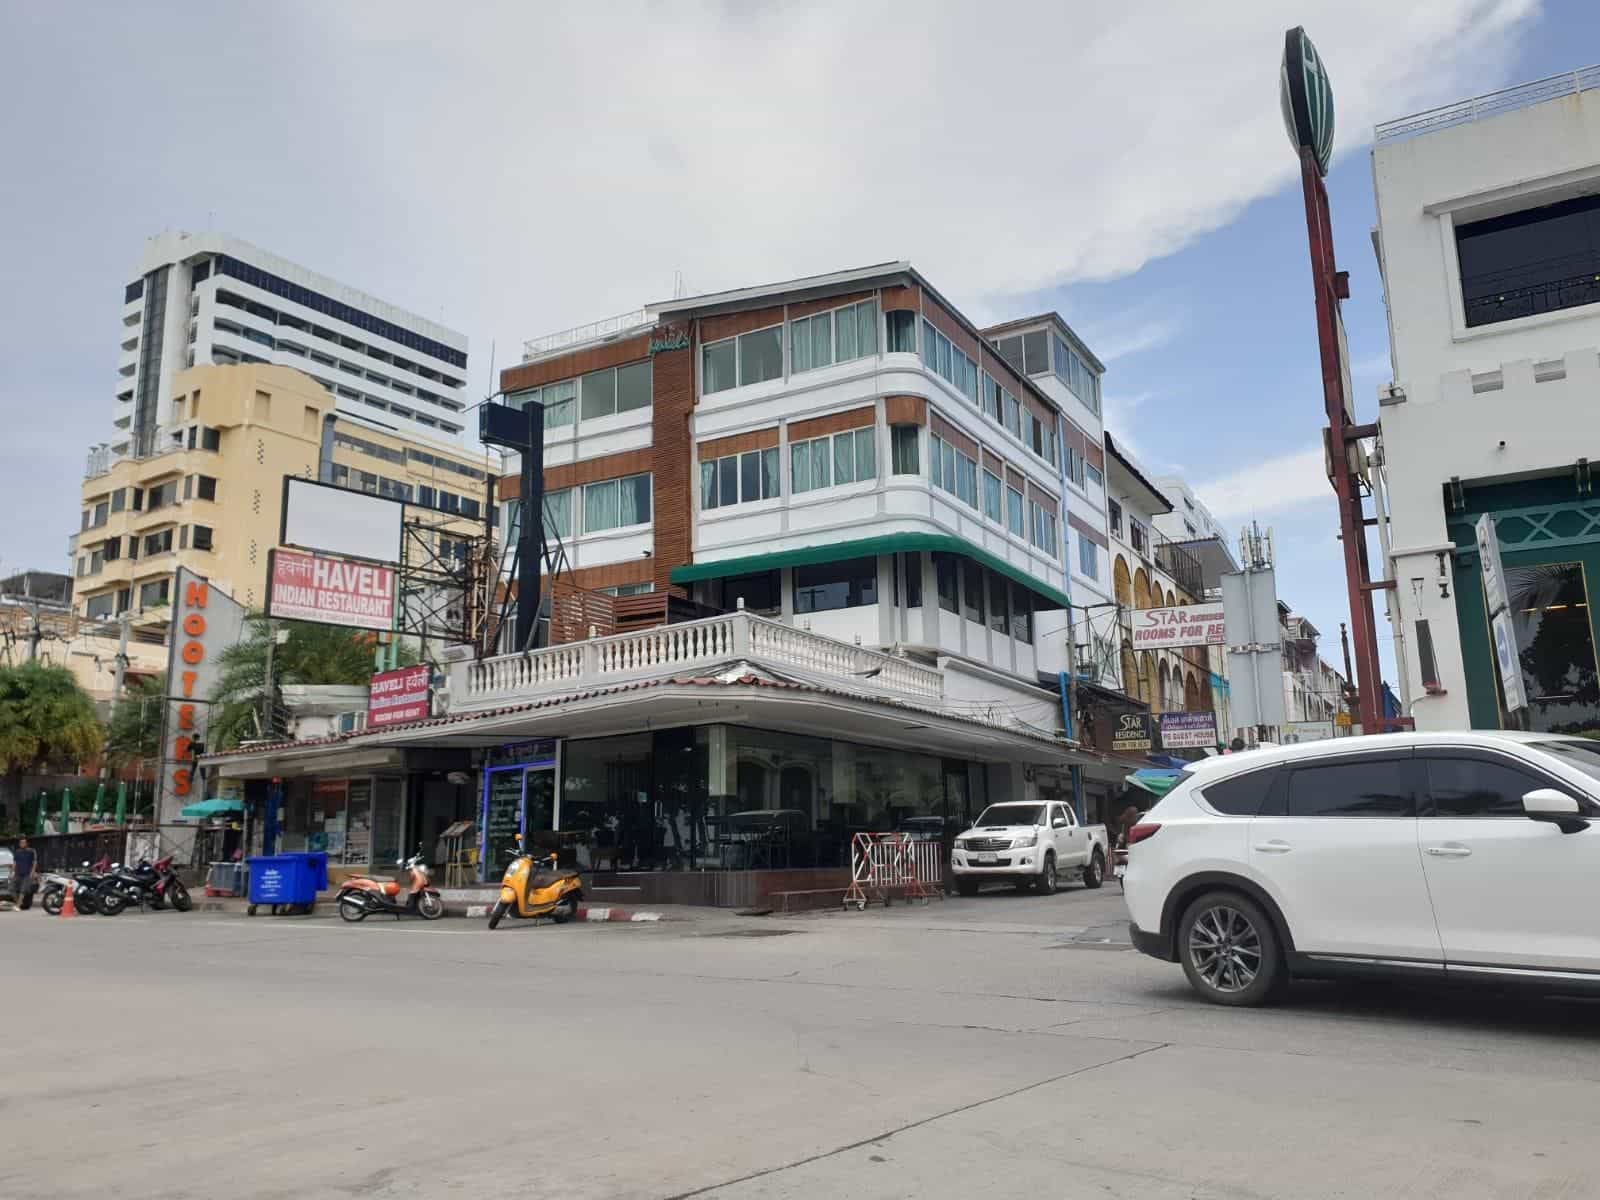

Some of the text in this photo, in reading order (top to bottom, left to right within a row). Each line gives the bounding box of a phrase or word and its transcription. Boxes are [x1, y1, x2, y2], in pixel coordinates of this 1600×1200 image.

[313, 559, 393, 597] HAVELI
[274, 583, 391, 616] INDIAN RESTAURANT
[1136, 609, 1188, 627] STAR
[1135, 627, 1176, 641] ROOMS
[1180, 625, 1203, 637] FOR
[173, 581, 209, 797] HOOTERS
[371, 678, 404, 694] HAVELI
[1119, 714, 1143, 731] STAR
